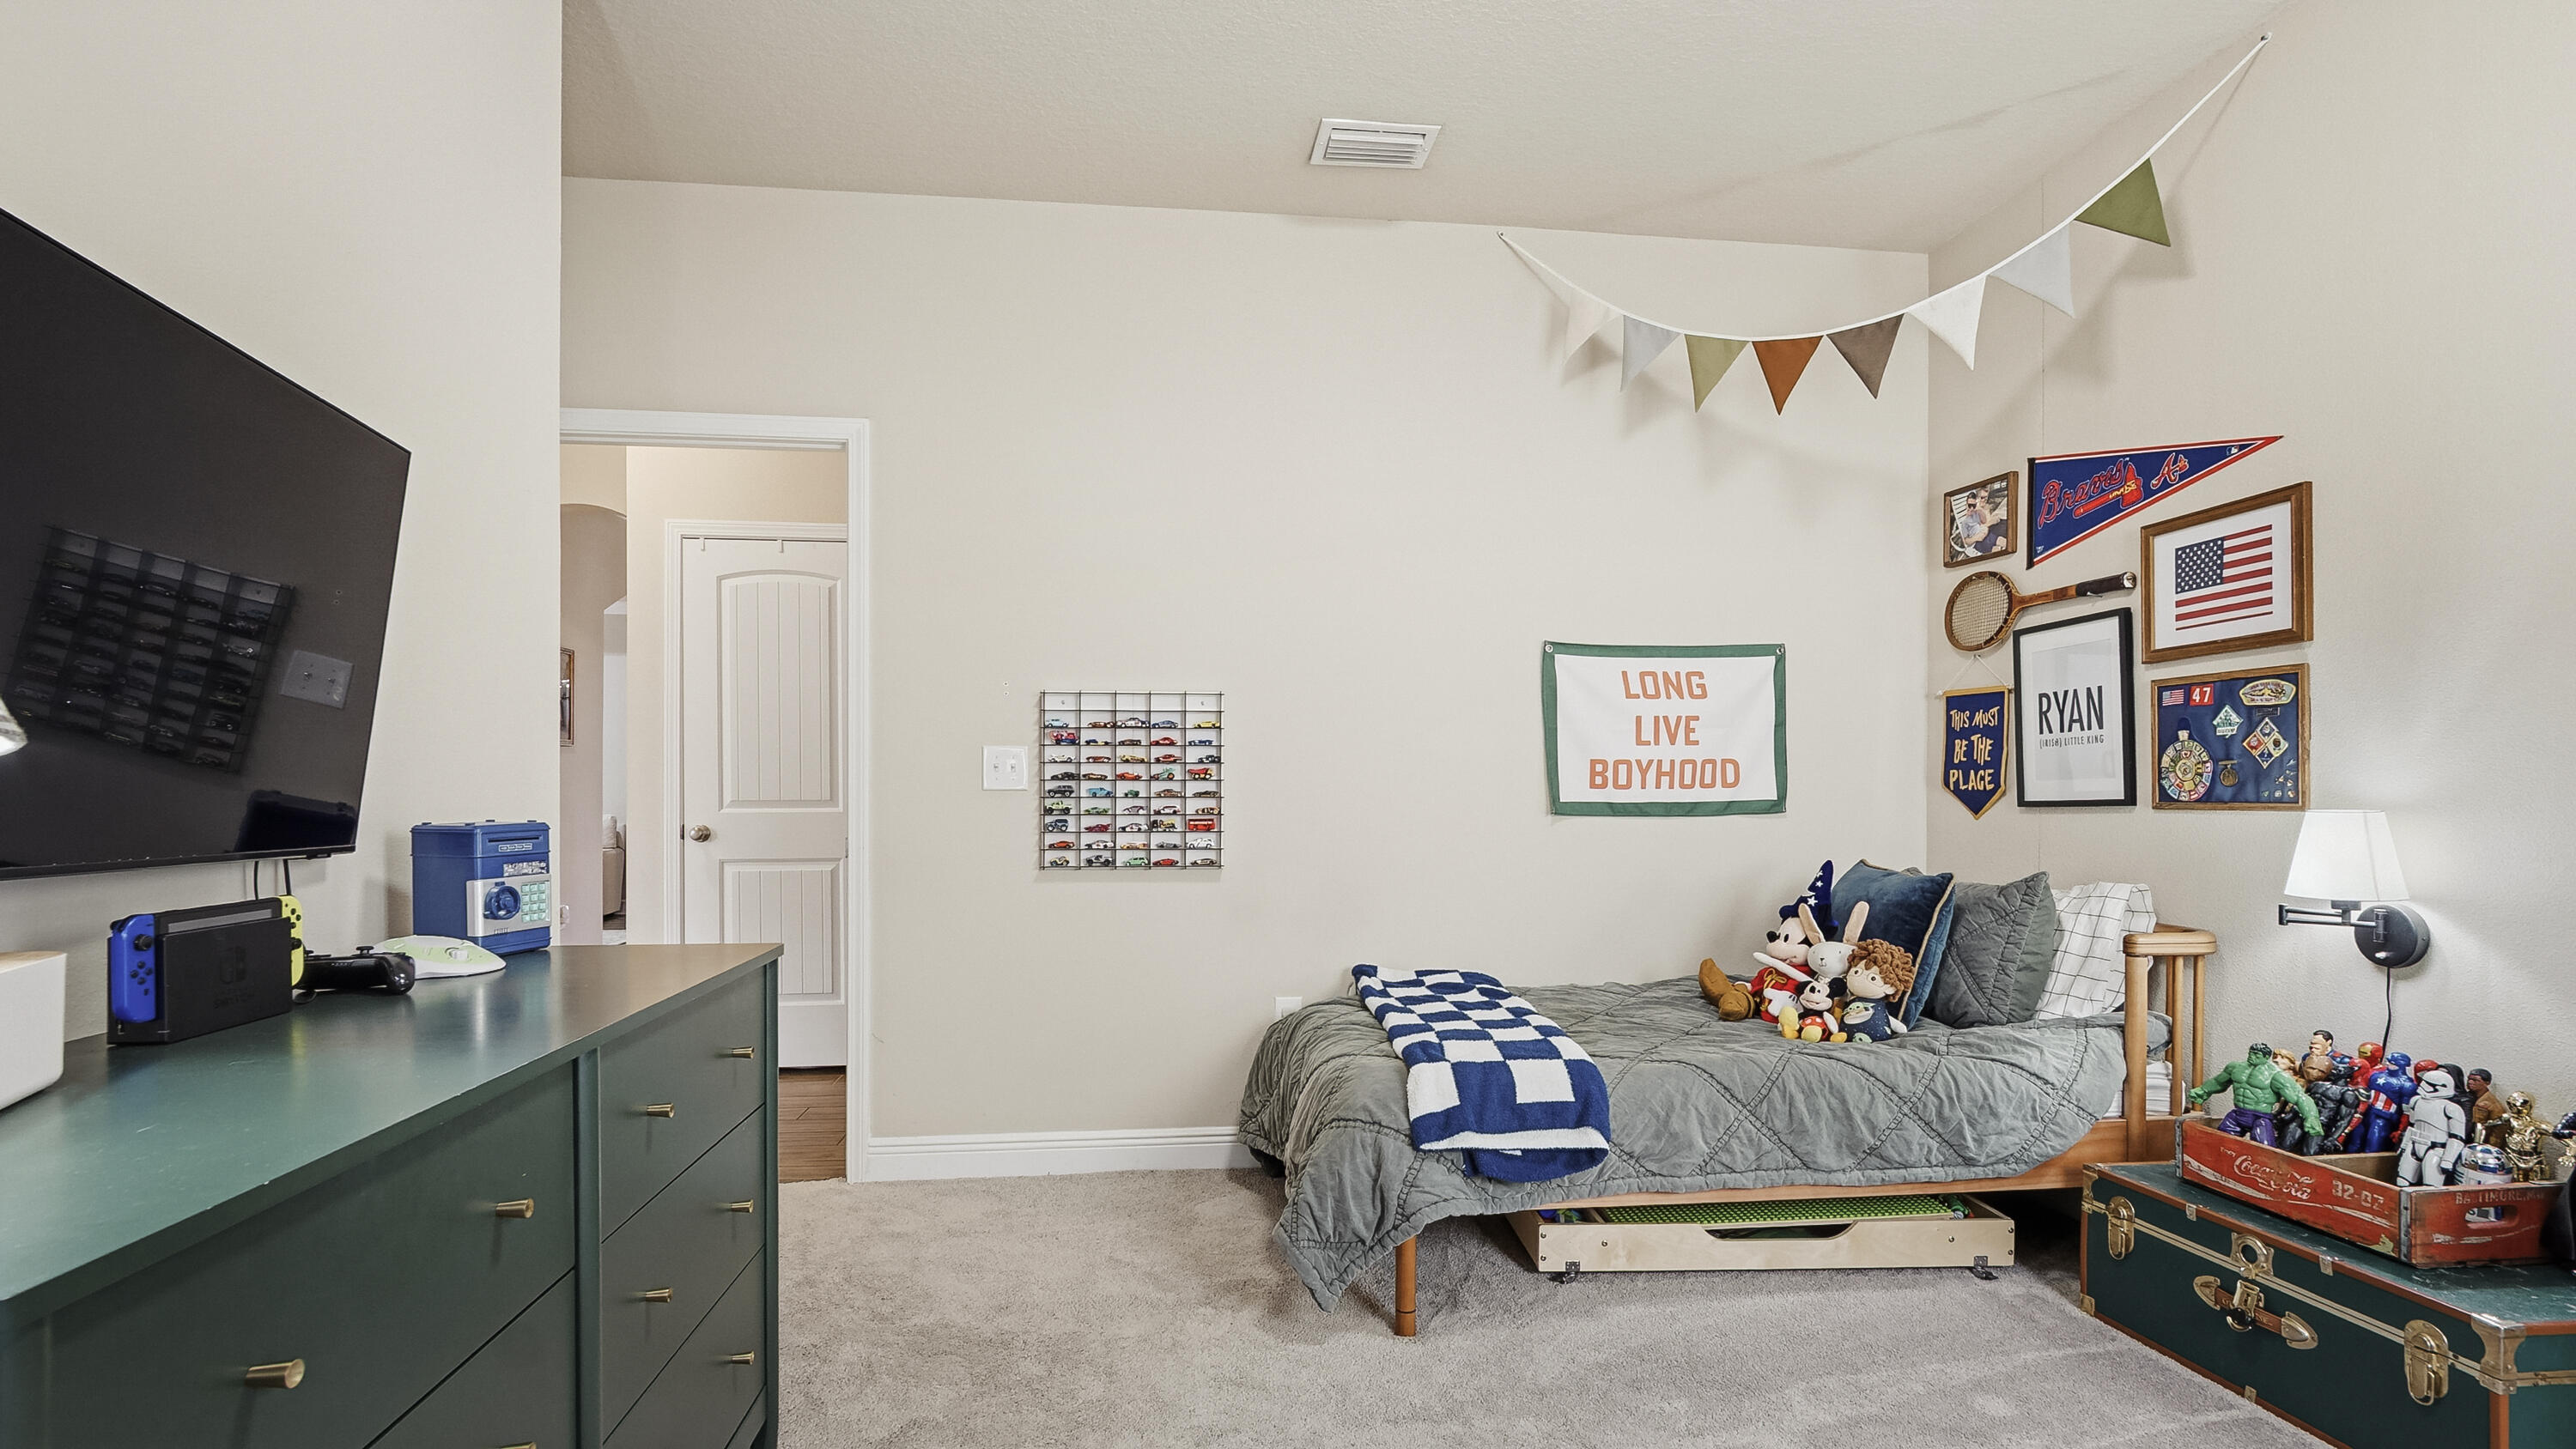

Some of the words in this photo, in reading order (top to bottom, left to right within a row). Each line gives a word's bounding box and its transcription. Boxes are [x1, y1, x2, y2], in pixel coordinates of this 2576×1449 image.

[2038, 458, 2124, 529] Braves
[1621, 670, 1708, 700] LONG
[2192, 688, 2211, 703] 47
[1950, 709, 1970, 731] THIS
[1971, 706, 2000, 728] MUST
[2038, 685, 2104, 735] RYAN
[1635, 716, 1699, 746] LIVE
[2064, 736, 2085, 746] LITTLE
[2087, 735, 2104, 744] KING
[1953, 739, 1968, 763] BE
[1971, 734, 1994, 766] THE
[1589, 759, 1741, 790] BOYHOOD
[1949, 769, 1995, 791] PLACE
[2233, 1155, 2316, 1200] CocaCola
